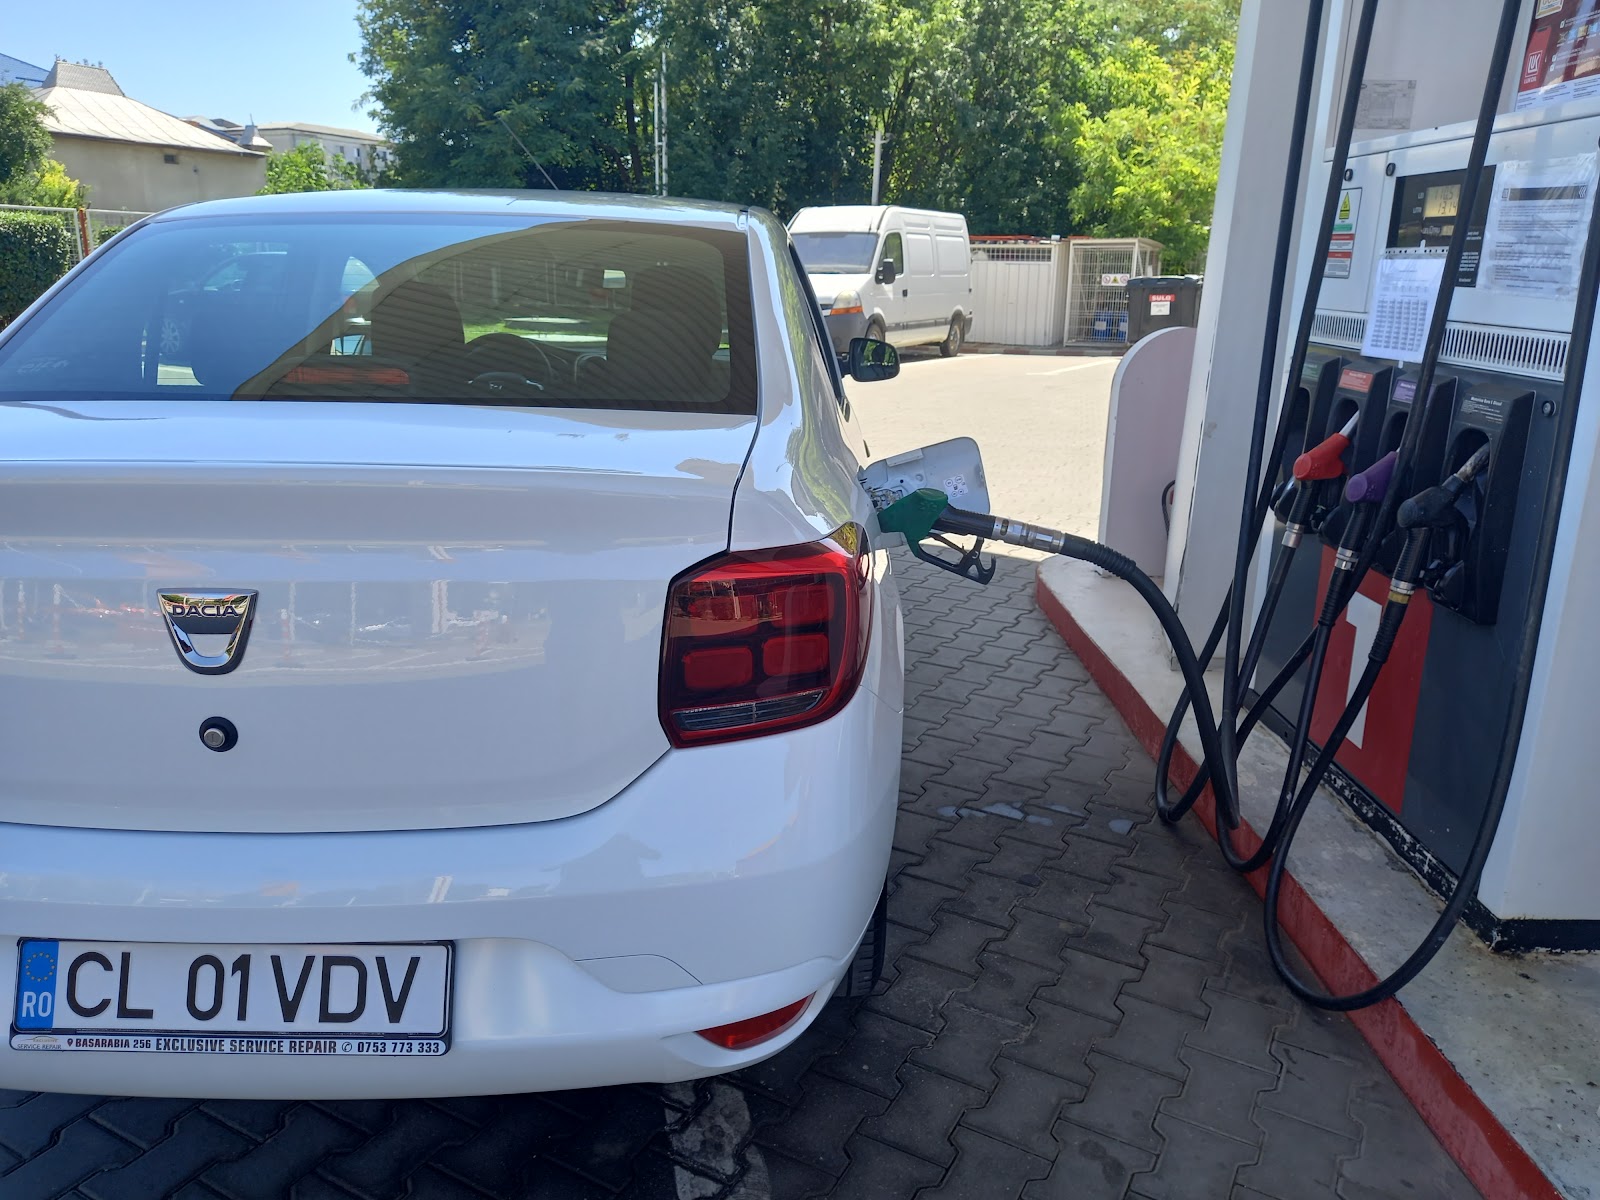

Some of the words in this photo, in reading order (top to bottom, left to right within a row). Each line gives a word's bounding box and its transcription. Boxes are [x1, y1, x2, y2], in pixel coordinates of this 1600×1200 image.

[172, 605, 239, 617] DACIA
[66, 951, 154, 1019] CL
[186, 953, 251, 1021] 01
[270, 955, 421, 1024] VDV
[21, 991, 52, 1018] RO
[75, 1038, 130, 1049] BASARABIA
[133, 1039, 151, 1049] 256
[155, 1038, 225, 1052] EXCLUSIVE
[229, 1039, 284, 1053] SERVICE
[288, 1040, 337, 1054] REPAIR
[357, 1041, 387, 1053] 0753
[391, 1041, 413, 1053] 773
[417, 1041, 440, 1053] 333
